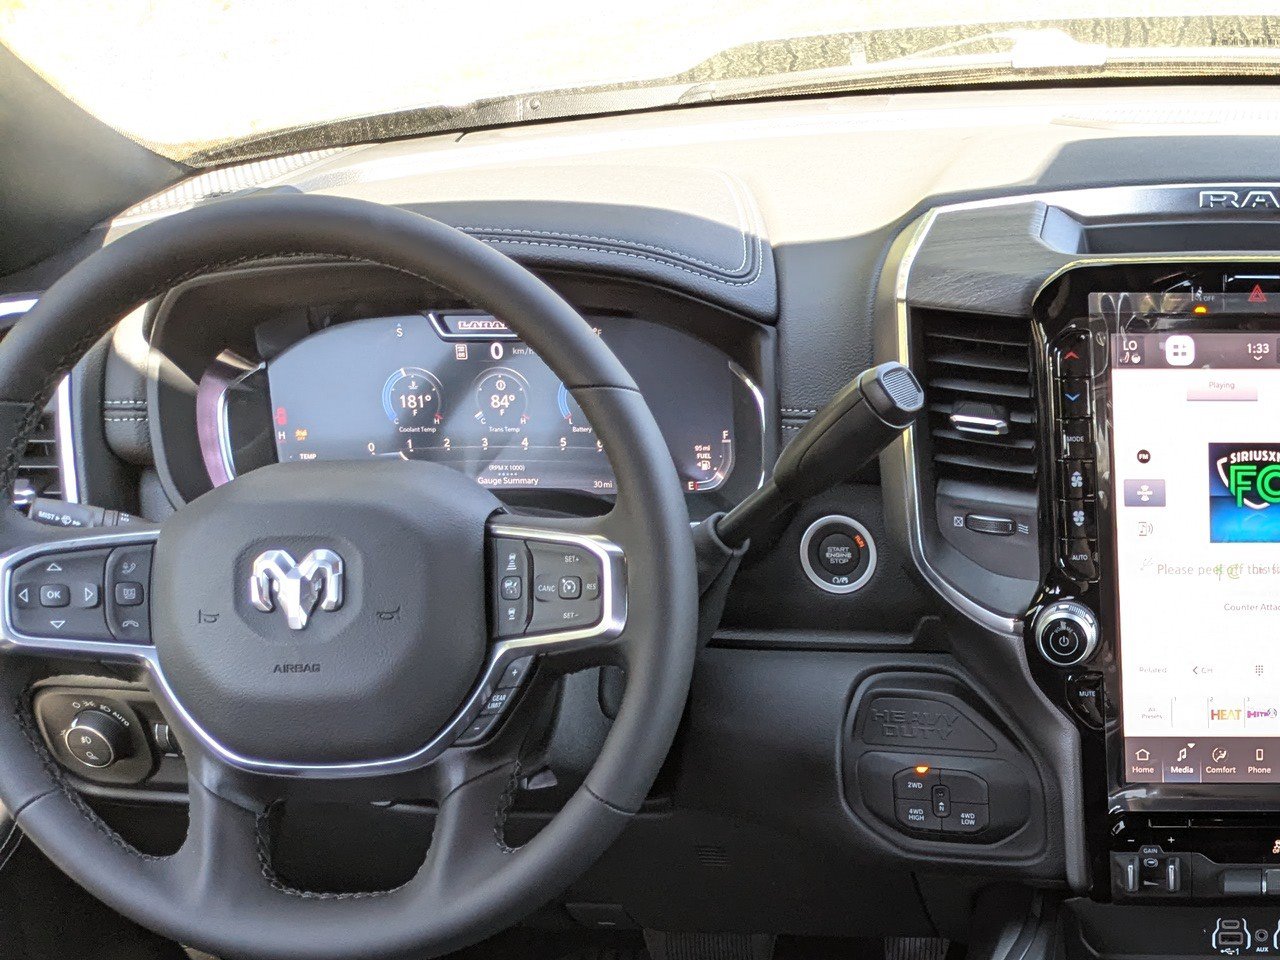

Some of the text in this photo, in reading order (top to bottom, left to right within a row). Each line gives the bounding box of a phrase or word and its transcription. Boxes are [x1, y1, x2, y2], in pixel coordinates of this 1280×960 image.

[458, 321, 508, 329] LARA
[396, 328, 403, 337] S
[1123, 341, 1138, 351] LO
[1246, 343, 1270, 353] 1:33
[490, 342, 504, 360] 0
[1208, 381, 1235, 390] Playing
[399, 394, 432, 408] 181°
[490, 394, 516, 408] 84°
[420, 426, 437, 434] Temp
[504, 426, 520, 434] Temp
[572, 426, 593, 434] Battery
[722, 430, 729, 439] F
[278, 431, 286, 440] H
[367, 443, 375, 452] 0
[407, 439, 412, 449] 1
[444, 438, 451, 448] 2
[482, 438, 489, 447] 3
[521, 438, 529, 447] 4
[560, 438, 567, 447] 5
[477, 476, 539, 486] Gauge Summary
[593, 480, 613, 488] 30 mi
[687, 482, 694, 491] E
[38, 510, 55, 520] MIST
[1157, 564, 1194, 575] Please
[1198, 564, 1223, 577] peel
[537, 584, 556, 593] CANC
[586, 583, 597, 591] RES
[46, 590, 61, 599] OK
[1224, 603, 1259, 611] Counter
[273, 663, 321, 674] AIRBAG
[487, 701, 502, 709] LIMIT
[112, 711, 130, 727] AUTO
[1210, 709, 1242, 721] HEAT
[1132, 766, 1155, 774] Home
[1170, 766, 1194, 774] Media
[1205, 766, 1236, 774] Comfort
[1247, 766, 1272, 774] Phone
[907, 781, 923, 789] 2WD
[960, 812, 976, 820] 4WD
[961, 818, 976, 826] LOW
